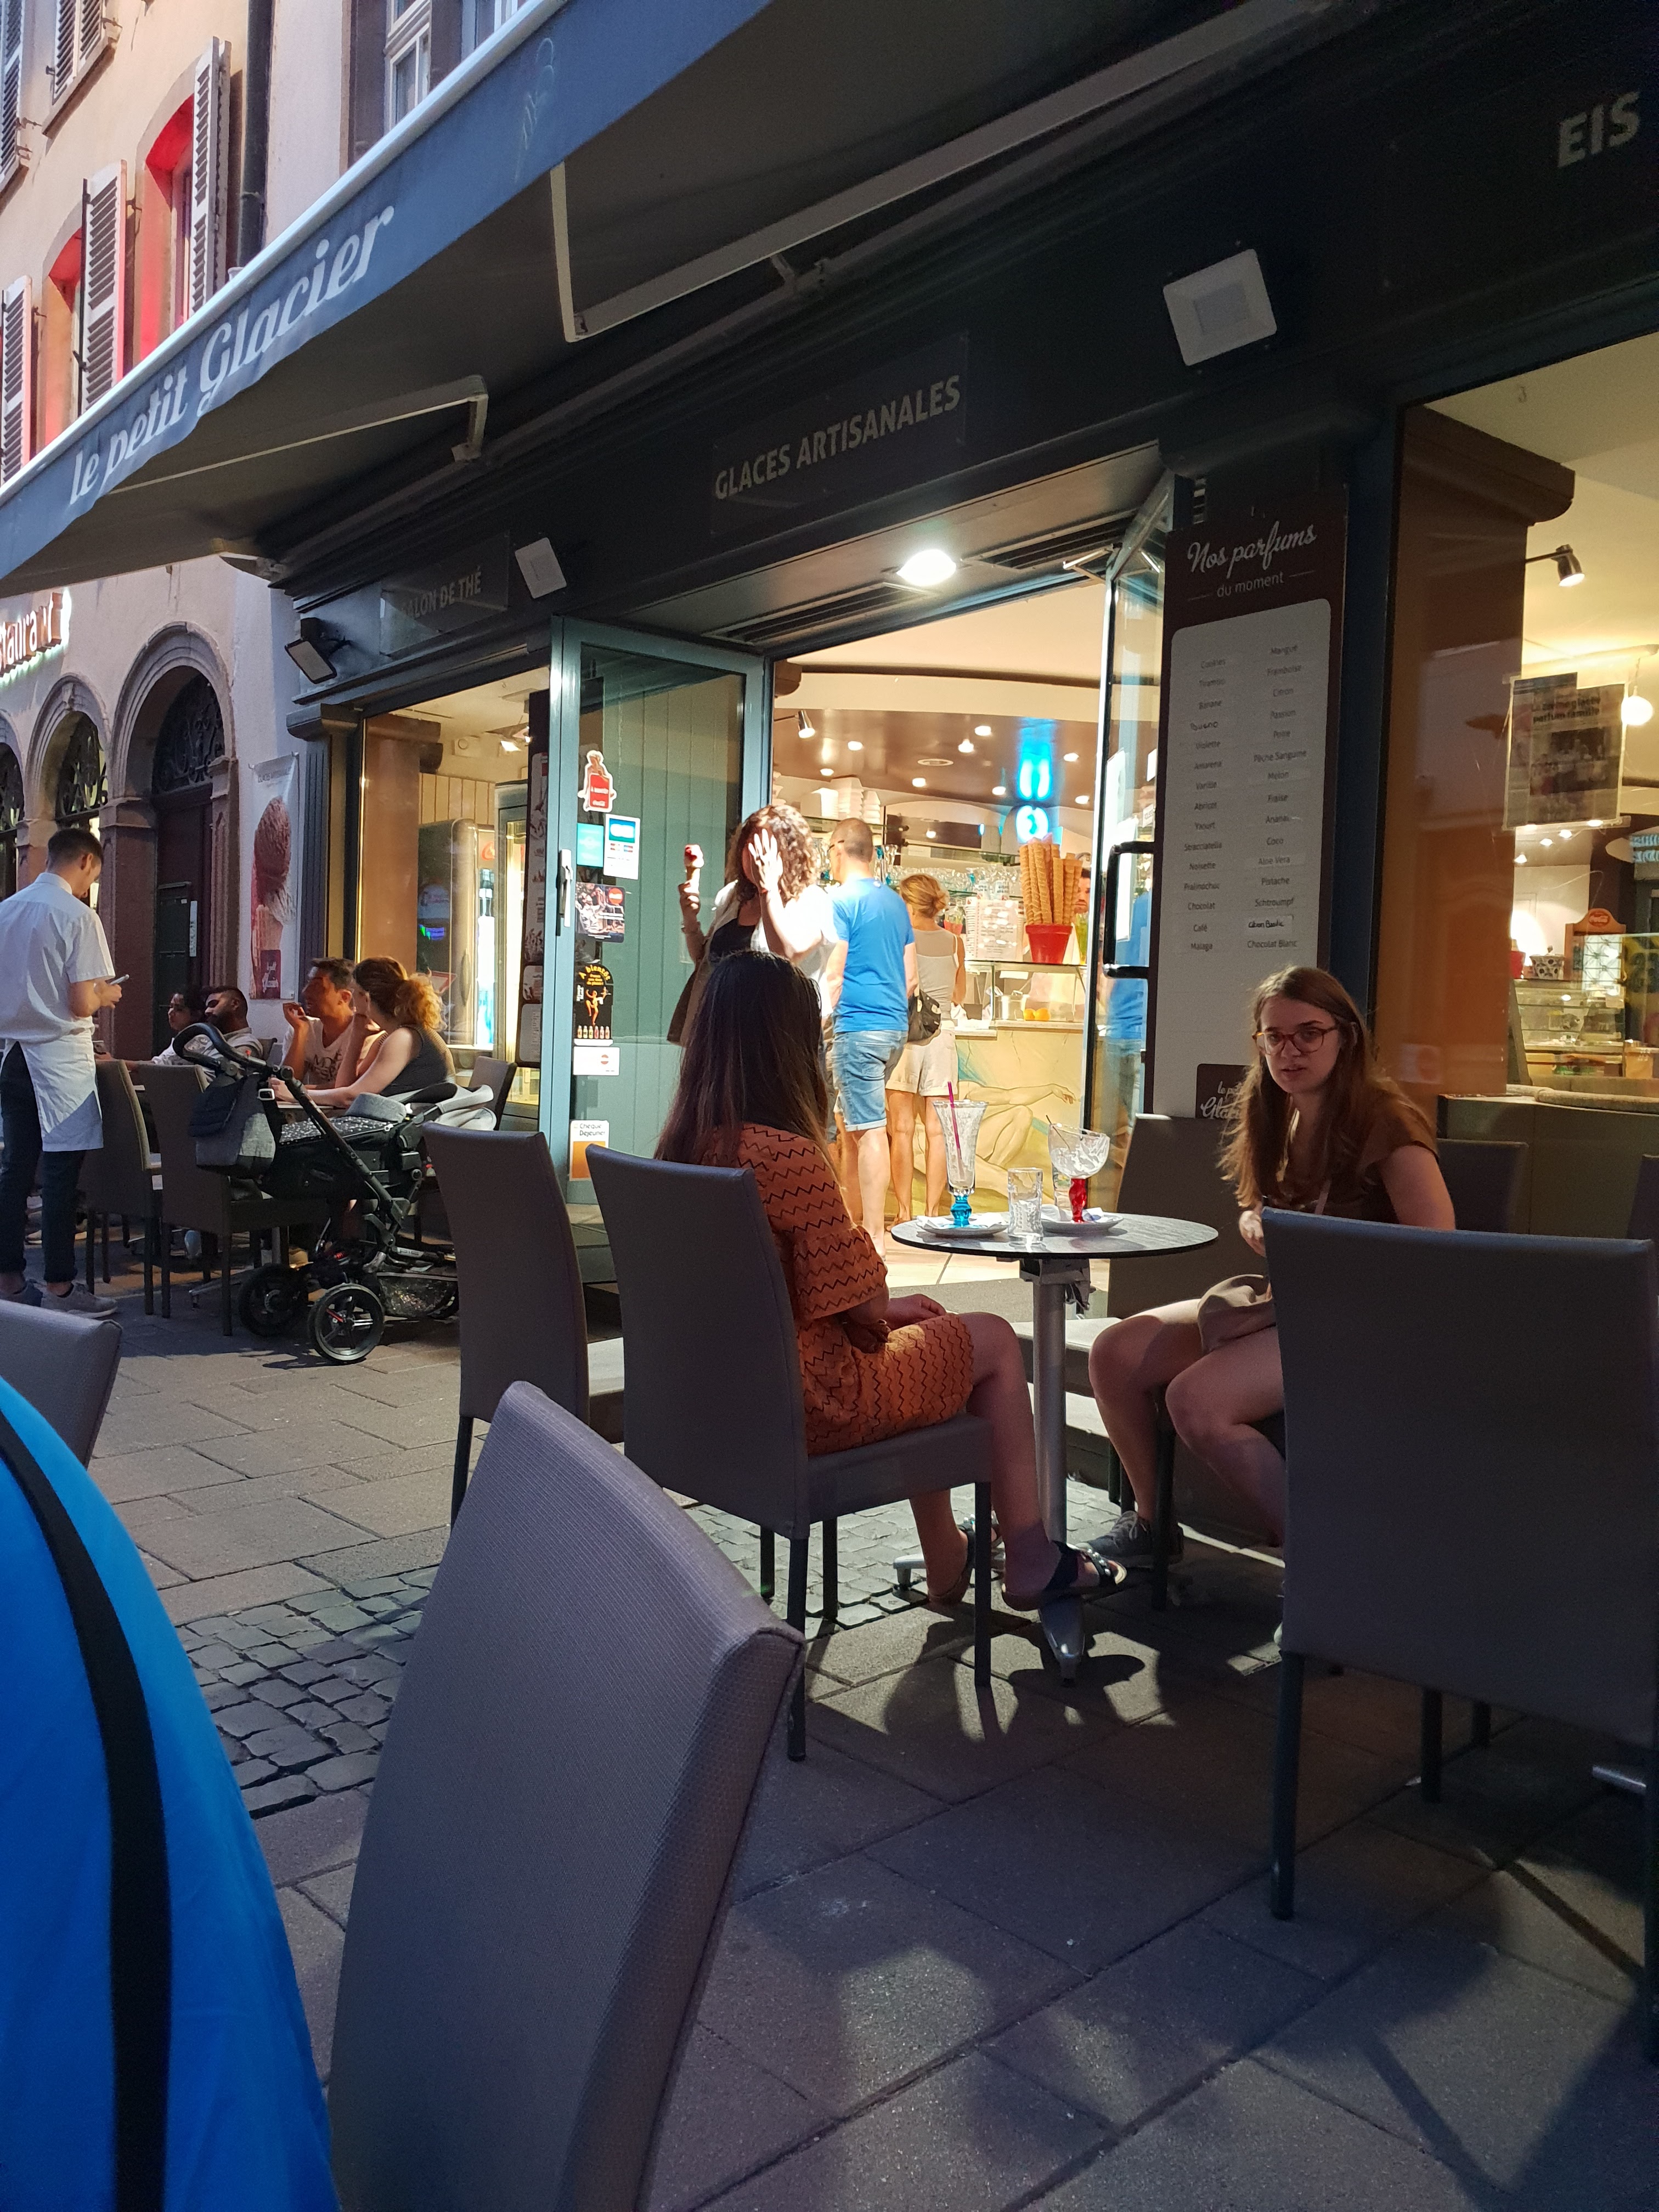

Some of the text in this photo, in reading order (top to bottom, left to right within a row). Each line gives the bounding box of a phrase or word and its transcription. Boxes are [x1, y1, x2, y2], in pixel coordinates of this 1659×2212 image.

[1558, 91, 1640, 168] EIS
[69, 206, 394, 505] le petit Glacier
[715, 375, 961, 500] GLACES ARTISANALES
[1187, 520, 1318, 579] Nos parfums
[439, 582, 455, 609] DE
[458, 565, 482, 600] THÉ
[1216, 571, 1285, 598] du moment
[0, 593, 63, 670] taurant
[1267, 665, 1302, 676] Framboise
[1190, 721, 1218, 731] Bueno
[1267, 771, 1289, 780] Melon
[1266, 837, 1284, 846] Coco
[1189, 861, 1217, 871] Noisette
[1258, 856, 1290, 866] Aloe Vera
[1261, 877, 1290, 886] Pistache
[1187, 902, 1216, 911] Chocolat
[1254, 897, 1295, 908] Schtroumpf
[1193, 923, 1208, 933] Café
[1246, 939, 1297, 949] Chocolat Blanc
